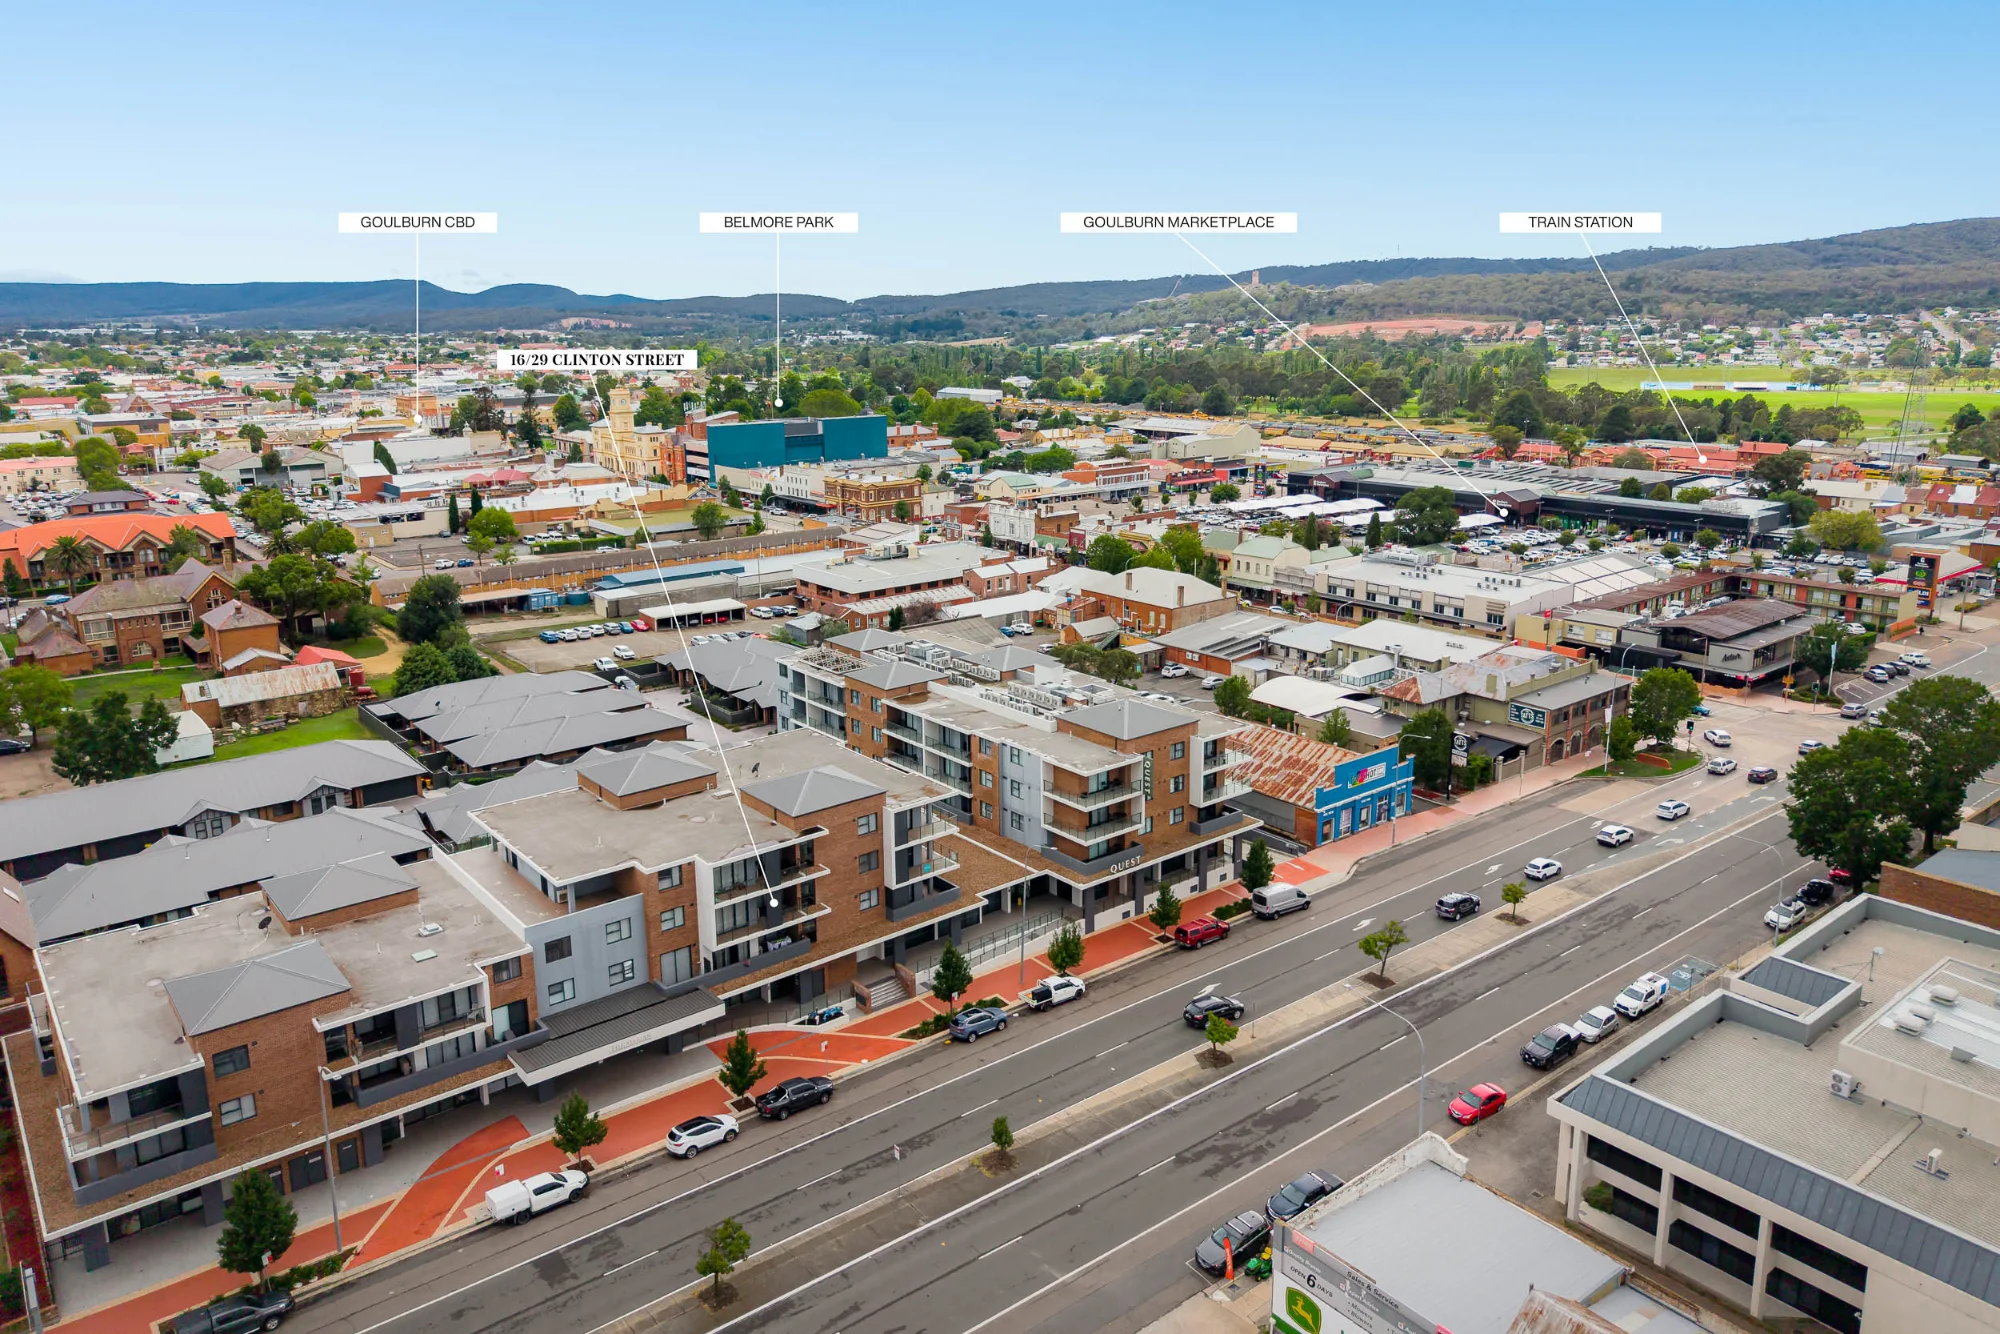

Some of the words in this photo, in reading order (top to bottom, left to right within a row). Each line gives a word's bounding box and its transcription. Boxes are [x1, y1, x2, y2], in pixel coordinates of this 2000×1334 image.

[1110, 856, 1141, 874] QUEST
[1290, 1265, 1306, 1280] OPEN
[1307, 1274, 1317, 1288] 6
[1316, 1283, 1333, 1298] DAYS
[1346, 1271, 1365, 1287] Sales
[1366, 1283, 1372, 1292] &
[1373, 1288, 1399, 1310] Service
